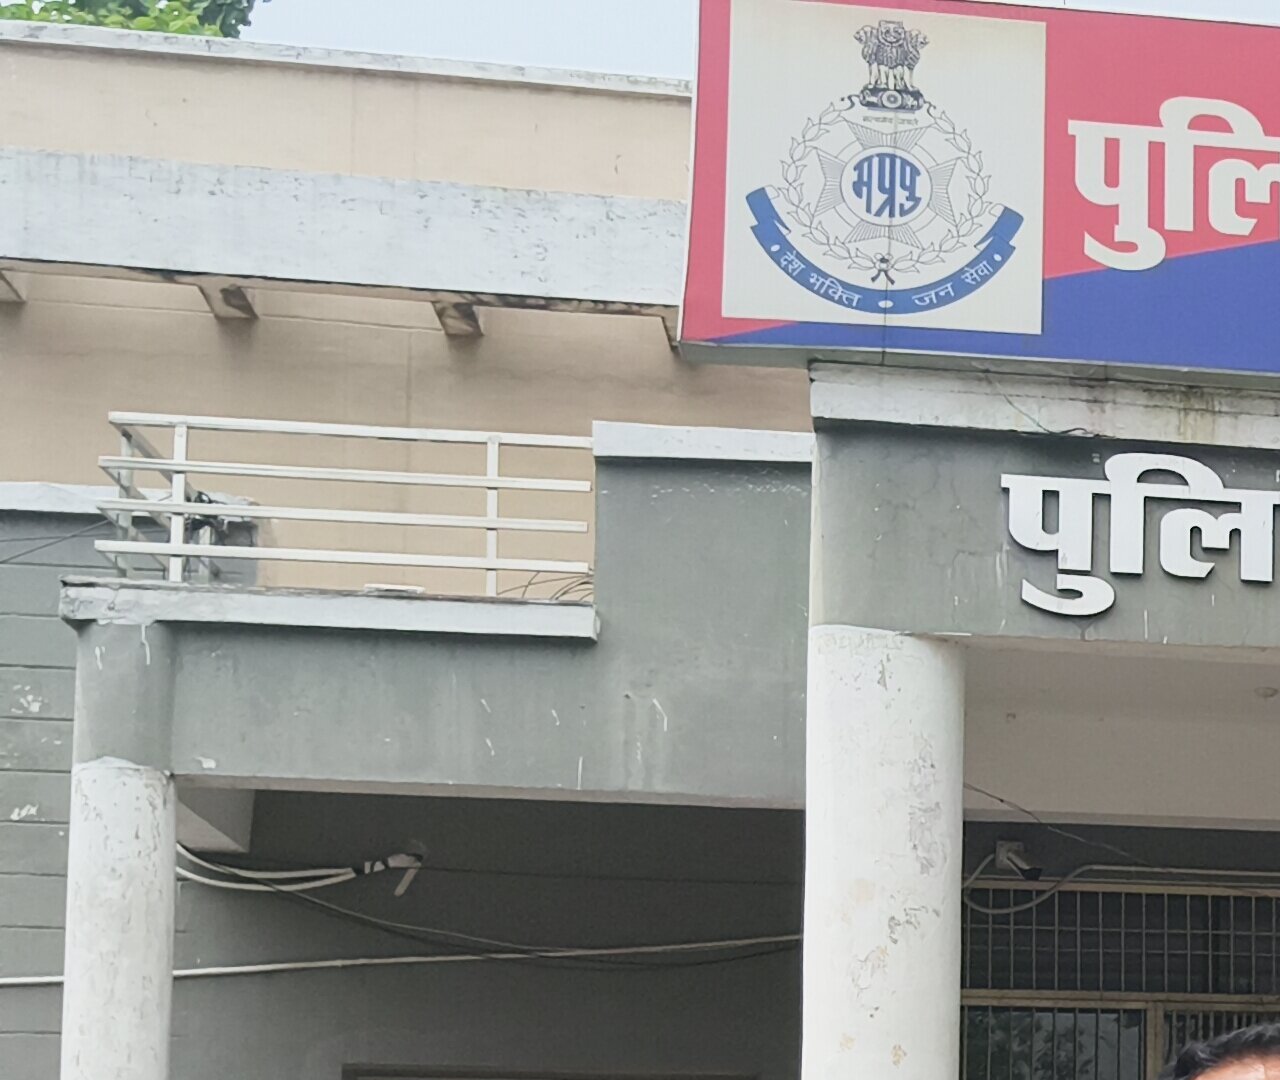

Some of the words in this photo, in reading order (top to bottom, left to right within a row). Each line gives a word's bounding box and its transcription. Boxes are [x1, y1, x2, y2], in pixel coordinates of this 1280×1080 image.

[779, 250, 806, 277] देश
[809, 271, 863, 308] भक्ति
[912, 281, 955, 306] जन
[961, 260, 994, 286] सेवा
